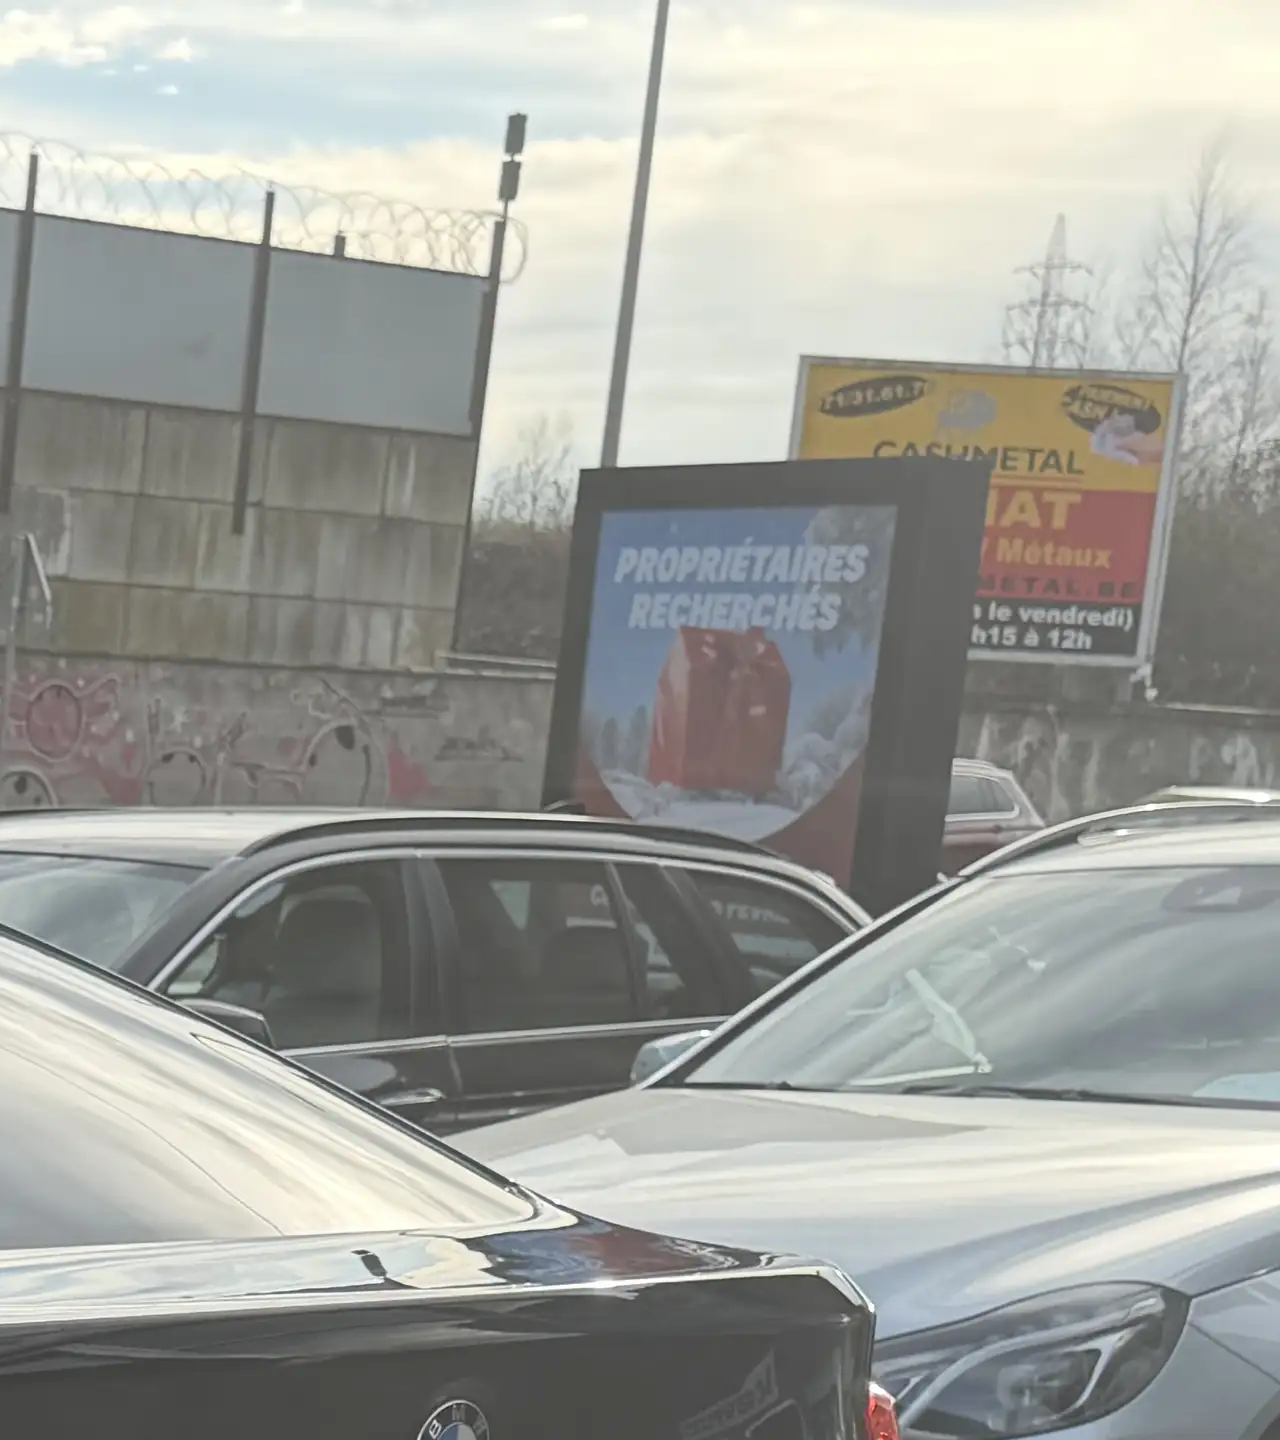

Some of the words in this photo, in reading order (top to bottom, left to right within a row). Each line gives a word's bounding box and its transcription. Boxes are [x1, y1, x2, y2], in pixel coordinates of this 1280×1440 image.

[614, 536, 869, 583] PROPRIÉTAIRES
[996, 536, 1112, 569] Métaux
[628, 584, 841, 630] RECHERCHÉS
[988, 600, 1013, 622] le
[1018, 605, 1134, 632] vendredi)
[1047, 627, 1093, 650] 12h
[428, 1403, 487, 1440] BMW
